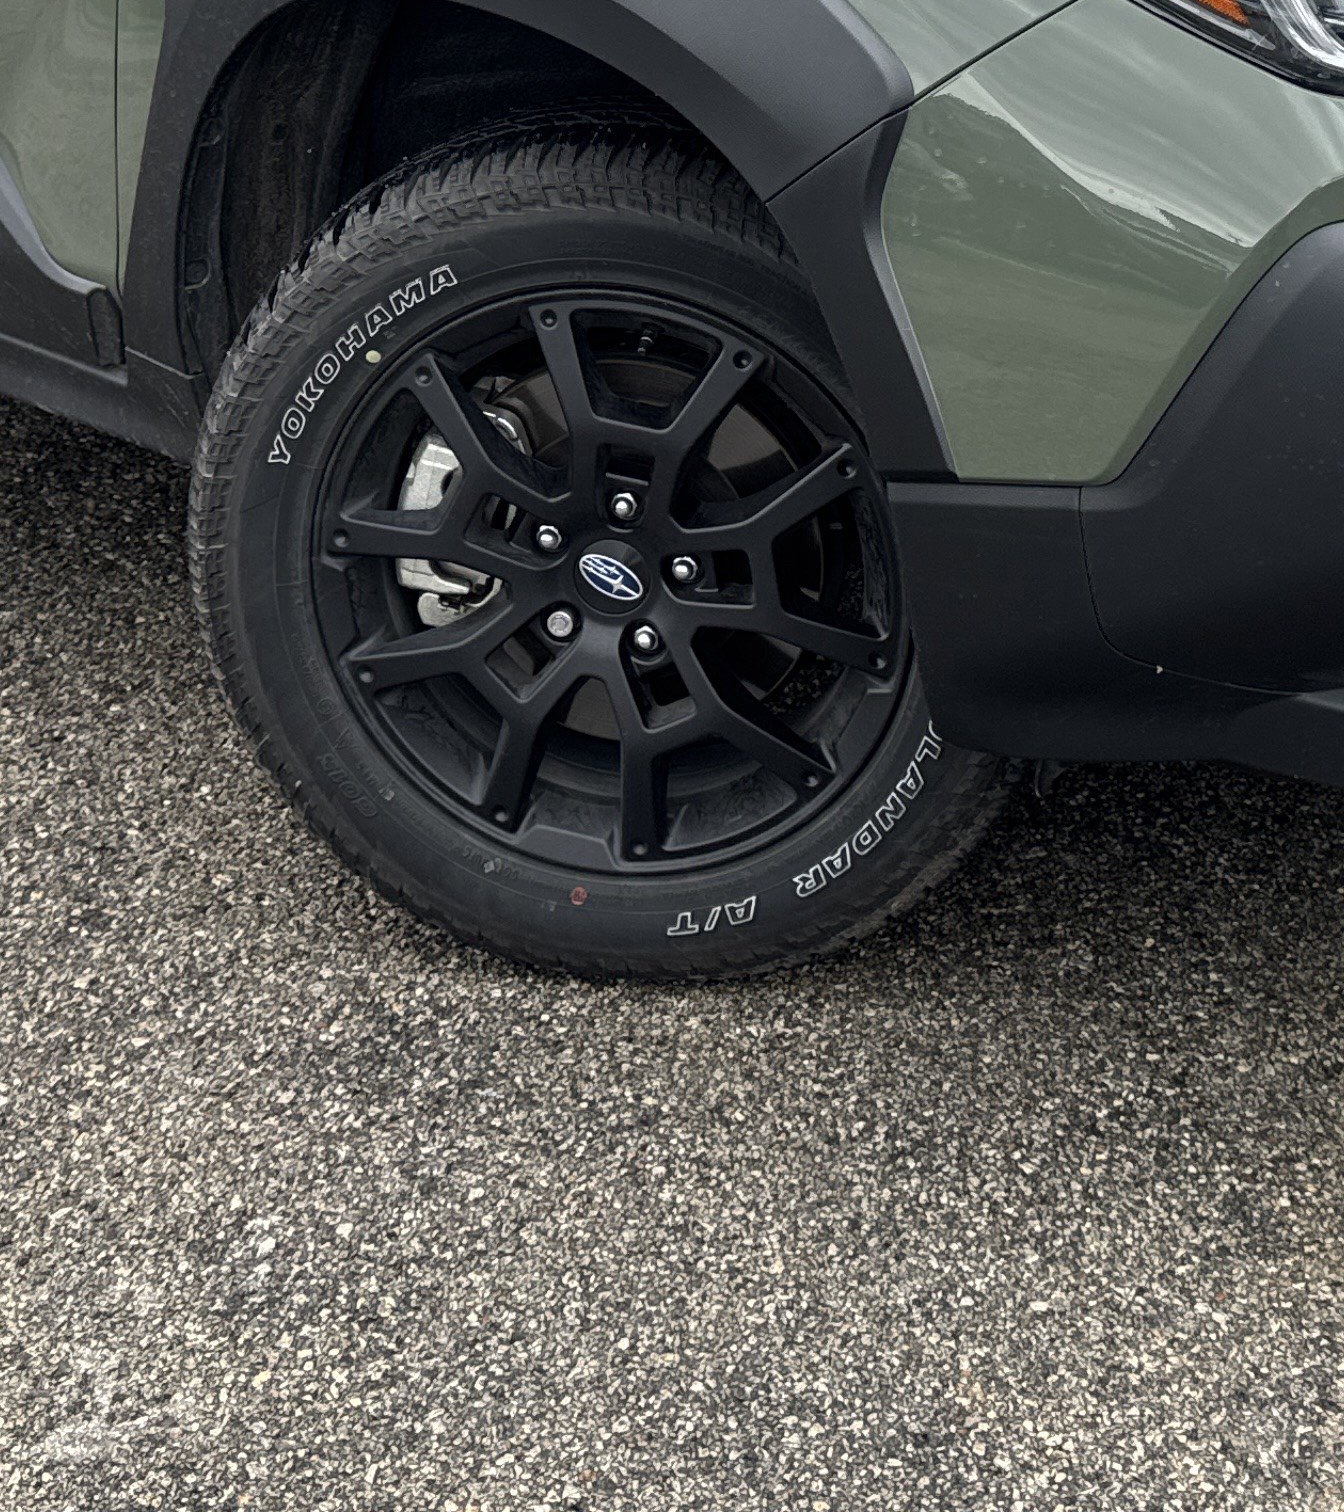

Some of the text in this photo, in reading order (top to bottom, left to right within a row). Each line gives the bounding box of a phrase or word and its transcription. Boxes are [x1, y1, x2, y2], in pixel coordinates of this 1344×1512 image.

[267, 264, 458, 465] YOKOHAMA
[666, 719, 943, 937] LANDAR A/T
